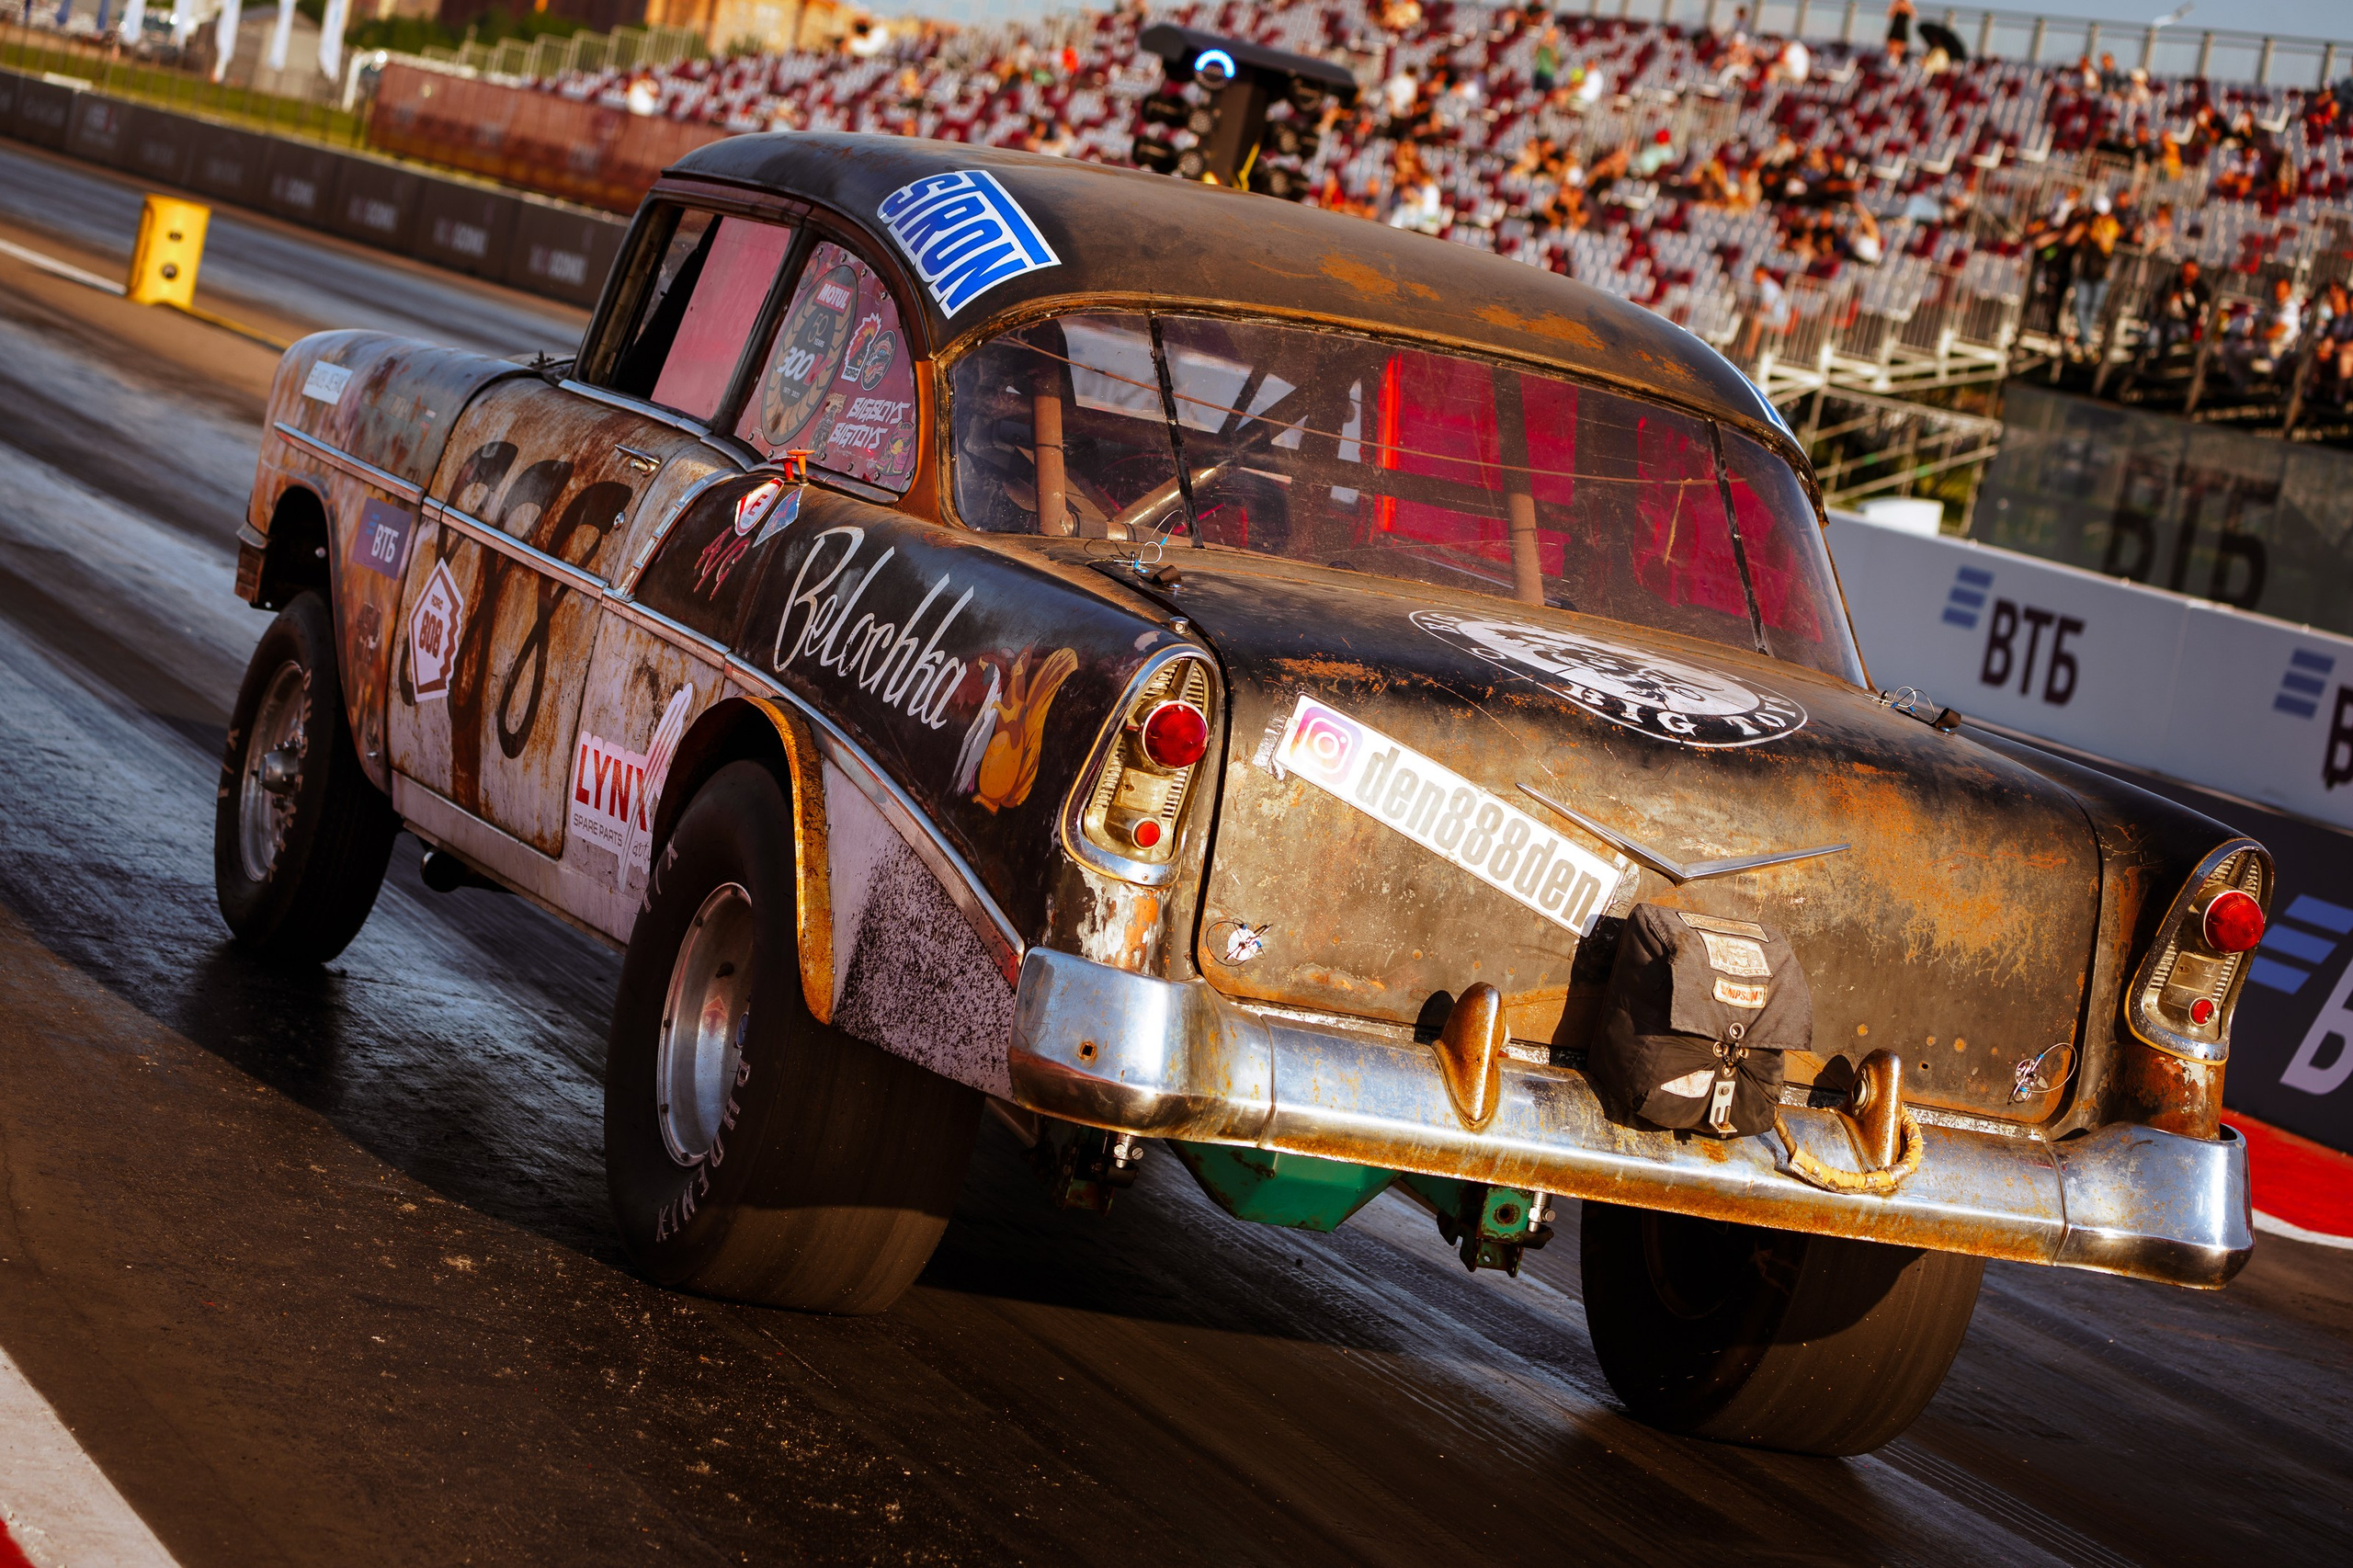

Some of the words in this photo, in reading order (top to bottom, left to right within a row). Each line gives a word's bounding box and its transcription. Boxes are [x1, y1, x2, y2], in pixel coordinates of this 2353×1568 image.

[881, 170, 1052, 312] STRON
[817, 283, 850, 310] MOTUL
[807, 312, 829, 343] 50
[777, 346, 833, 387] 300V
[747, 494, 768, 517] E
[370, 523, 400, 564] ВТБ
[419, 609, 444, 660] 808
[774, 525, 975, 731] Belochka
[1980, 597, 2086, 708] ВТБ
[1563, 681, 1699, 736] BIG
[1724, 693, 1797, 736] TOYS
[574, 742, 654, 833] LYNX
[573, 813, 598, 835] SPARE
[598, 824, 624, 847] PARTS
[1355, 746, 1603, 928] den888den
